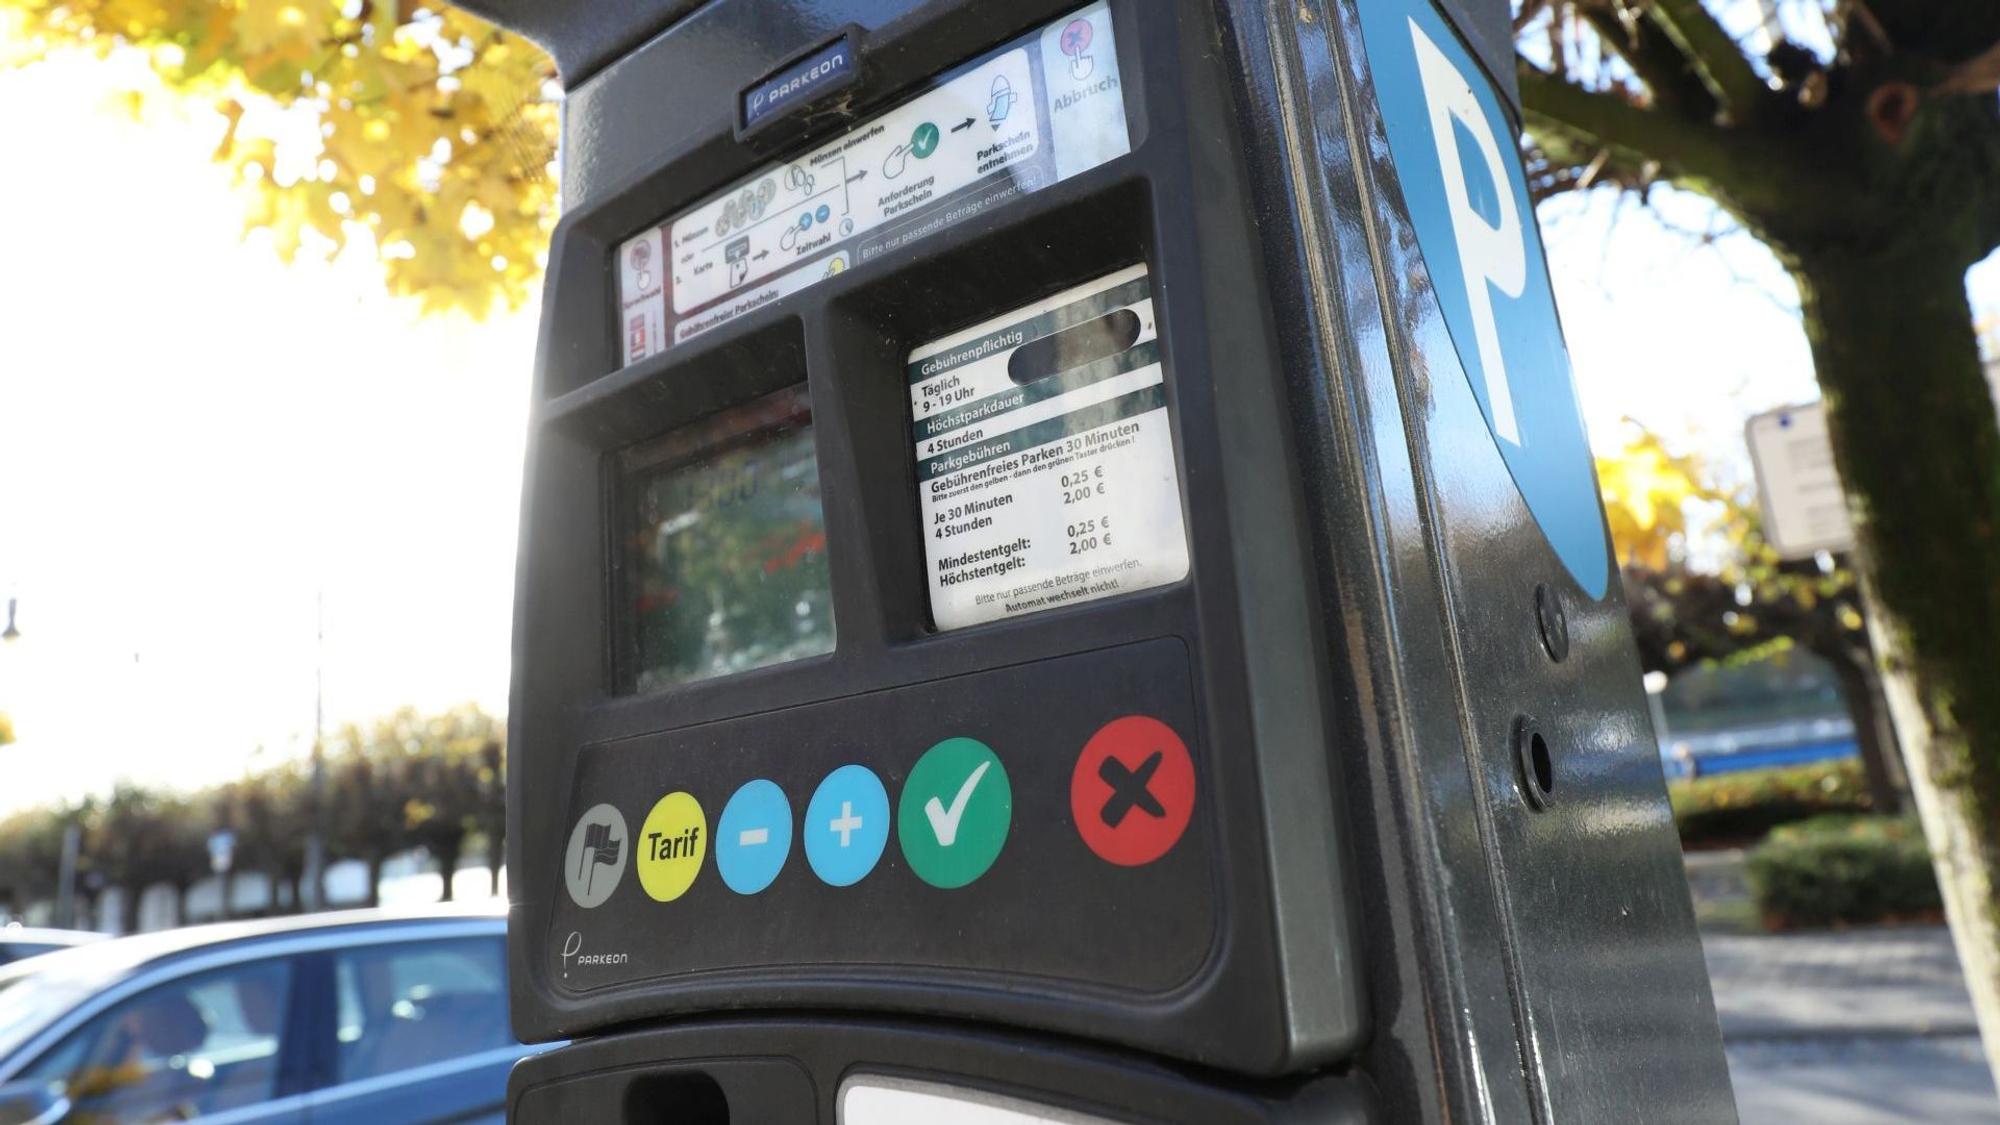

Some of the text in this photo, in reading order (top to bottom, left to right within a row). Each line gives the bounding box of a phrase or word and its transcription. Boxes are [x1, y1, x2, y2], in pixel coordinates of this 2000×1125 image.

[769, 54, 843, 103] PARKEON
[1054, 75, 1118, 112] Abbruch
[843, 125, 885, 151] einwerfen
[976, 130, 1031, 160] Parkschein
[977, 143, 1033, 173] entnehmen
[878, 175, 935, 207] Anforderung
[884, 190, 933, 217] Parkschein
[862, 177, 1037, 259] Bitte nur passende Beträge einwerfen!
[1408, 16, 1526, 447] P
[796, 232, 831, 255] Zeitwahl
[922, 376, 960, 397] Täglich
[923, 401, 930, 413] 9
[940, 393, 952, 407] 19
[954, 386, 975, 400] Uhr
[927, 394, 1024, 434] Höchstparkdauer
[927, 429, 983, 454] 4 Stunden
[931, 422, 1140, 493] Gebührenfreies Parken 30 Minuten
[931, 442, 1011, 474] Parkgebühren
[932, 493, 948, 503] Bitte
[949, 486, 969, 498] zuerst
[970, 483, 983, 492] den
[984, 475, 1009, 489] gelben
[1013, 468, 1031, 479] dann
[1032, 463, 1047, 473] den
[1047, 455, 1074, 470] grünen
[1075, 448, 1098, 460] Taster
[1100, 438, 1131, 453] drücken
[934, 465, 1103, 525] Je 30 Minuten 0,25 €
[935, 482, 1105, 539] 4 Stunden 2,00 €
[938, 515, 1110, 571] Mindestentgelt: 0,25 €
[940, 532, 1112, 587] Höchstentgelt: 2,00 €
[975, 592, 995, 605] Bitte
[996, 589, 1011, 600] nur
[1013, 579, 1054, 598] passende
[1005, 579, 1119, 613] Automat wechselt nicht!
[648, 827, 699, 861] Tarif
[577, 953, 628, 966] PARKEON
